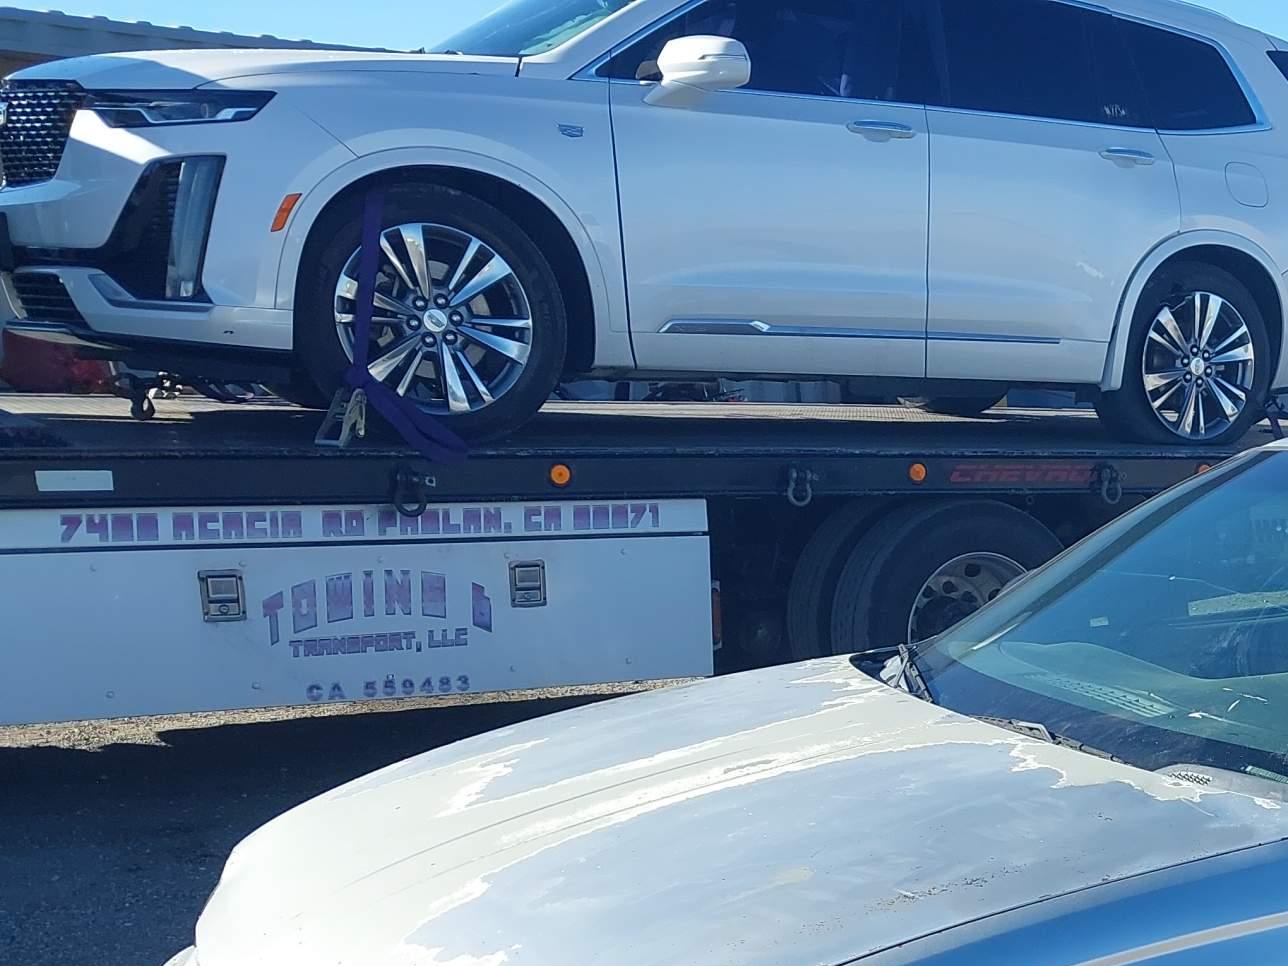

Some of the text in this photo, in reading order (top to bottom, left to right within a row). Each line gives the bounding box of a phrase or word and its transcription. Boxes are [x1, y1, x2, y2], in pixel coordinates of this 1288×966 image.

[949, 463, 1100, 483] CHEVRO
[172, 510, 302, 541] ACACIA
[523, 505, 563, 532] CA
[427, 627, 469, 649] LLC
[305, 682, 347, 702] CA
